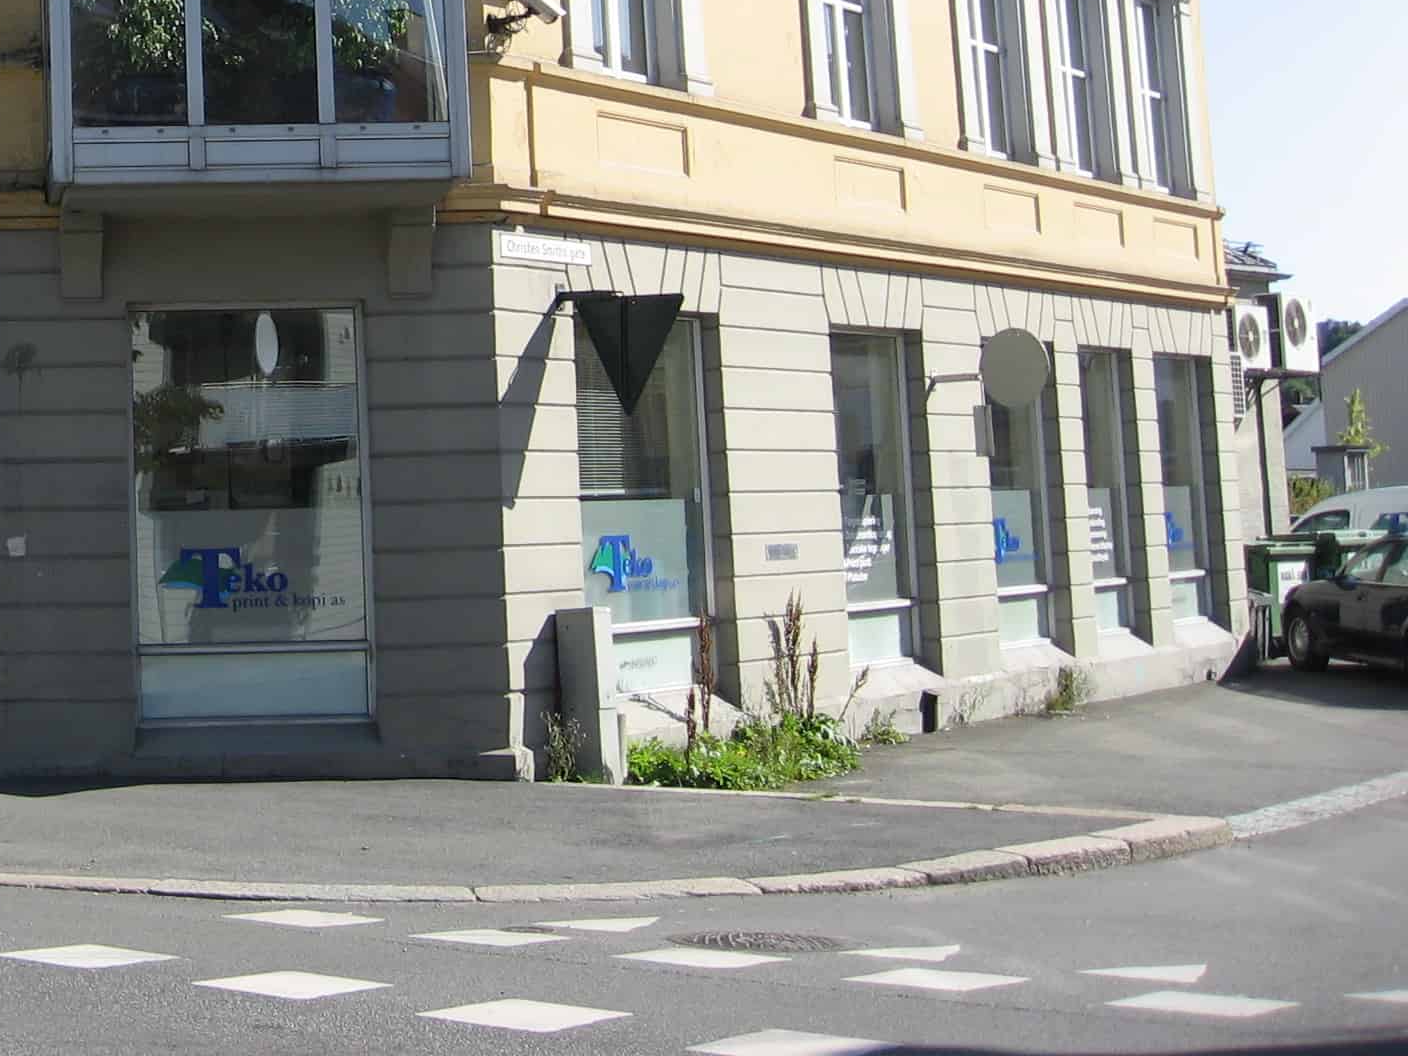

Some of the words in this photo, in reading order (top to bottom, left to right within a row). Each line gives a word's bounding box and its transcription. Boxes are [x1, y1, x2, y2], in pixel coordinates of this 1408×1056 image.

[180, 546, 290, 609] Teko
[232, 594, 270, 613] print
[274, 595, 290, 608] &
[293, 592, 327, 613] kopi
[330, 596, 347, 608] as
